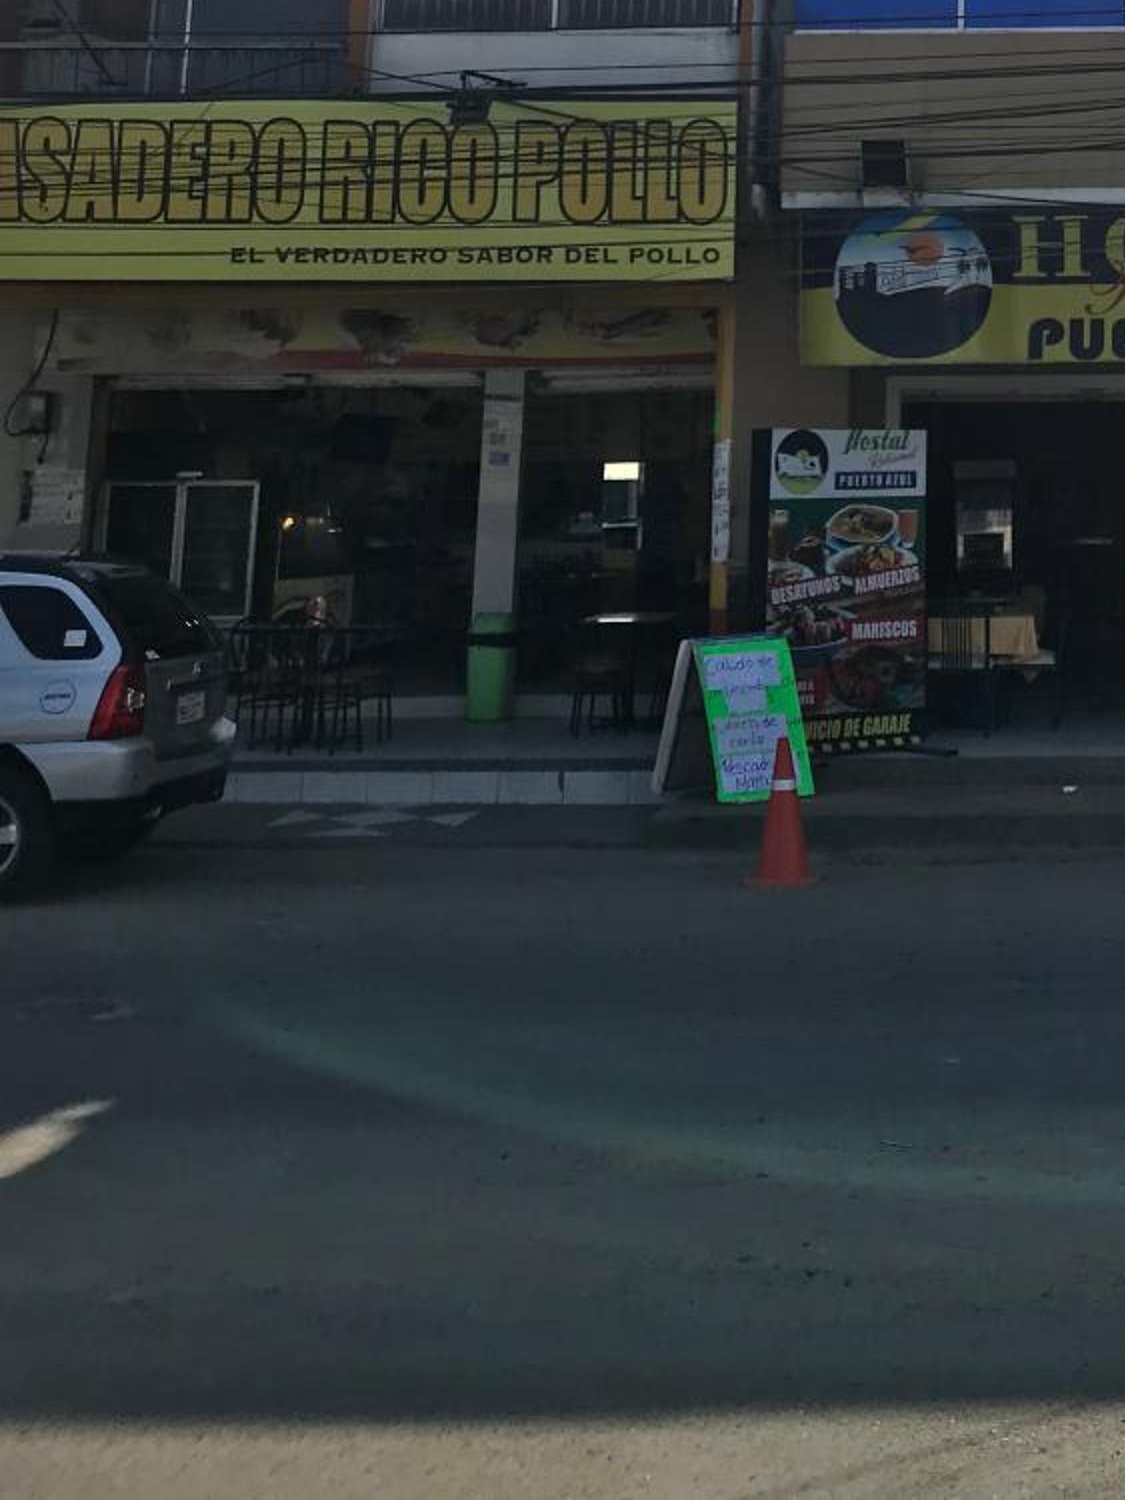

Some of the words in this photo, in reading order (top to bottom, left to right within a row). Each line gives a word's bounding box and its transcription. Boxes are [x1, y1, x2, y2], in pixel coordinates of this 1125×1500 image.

[318, 117, 498, 225] RICO
[512, 116, 728, 225] POLLO
[230, 247, 265, 264] EL
[275, 247, 447, 265] VERDADERO
[456, 246, 553, 264] SABOR
[564, 247, 619, 264] DEL
[628, 246, 721, 265] POLLO
[844, 428, 911, 454] Hostal
[851, 620, 917, 640] MARISCOS
[843, 716, 861, 738] DE
[864, 712, 912, 737] GARAJE
